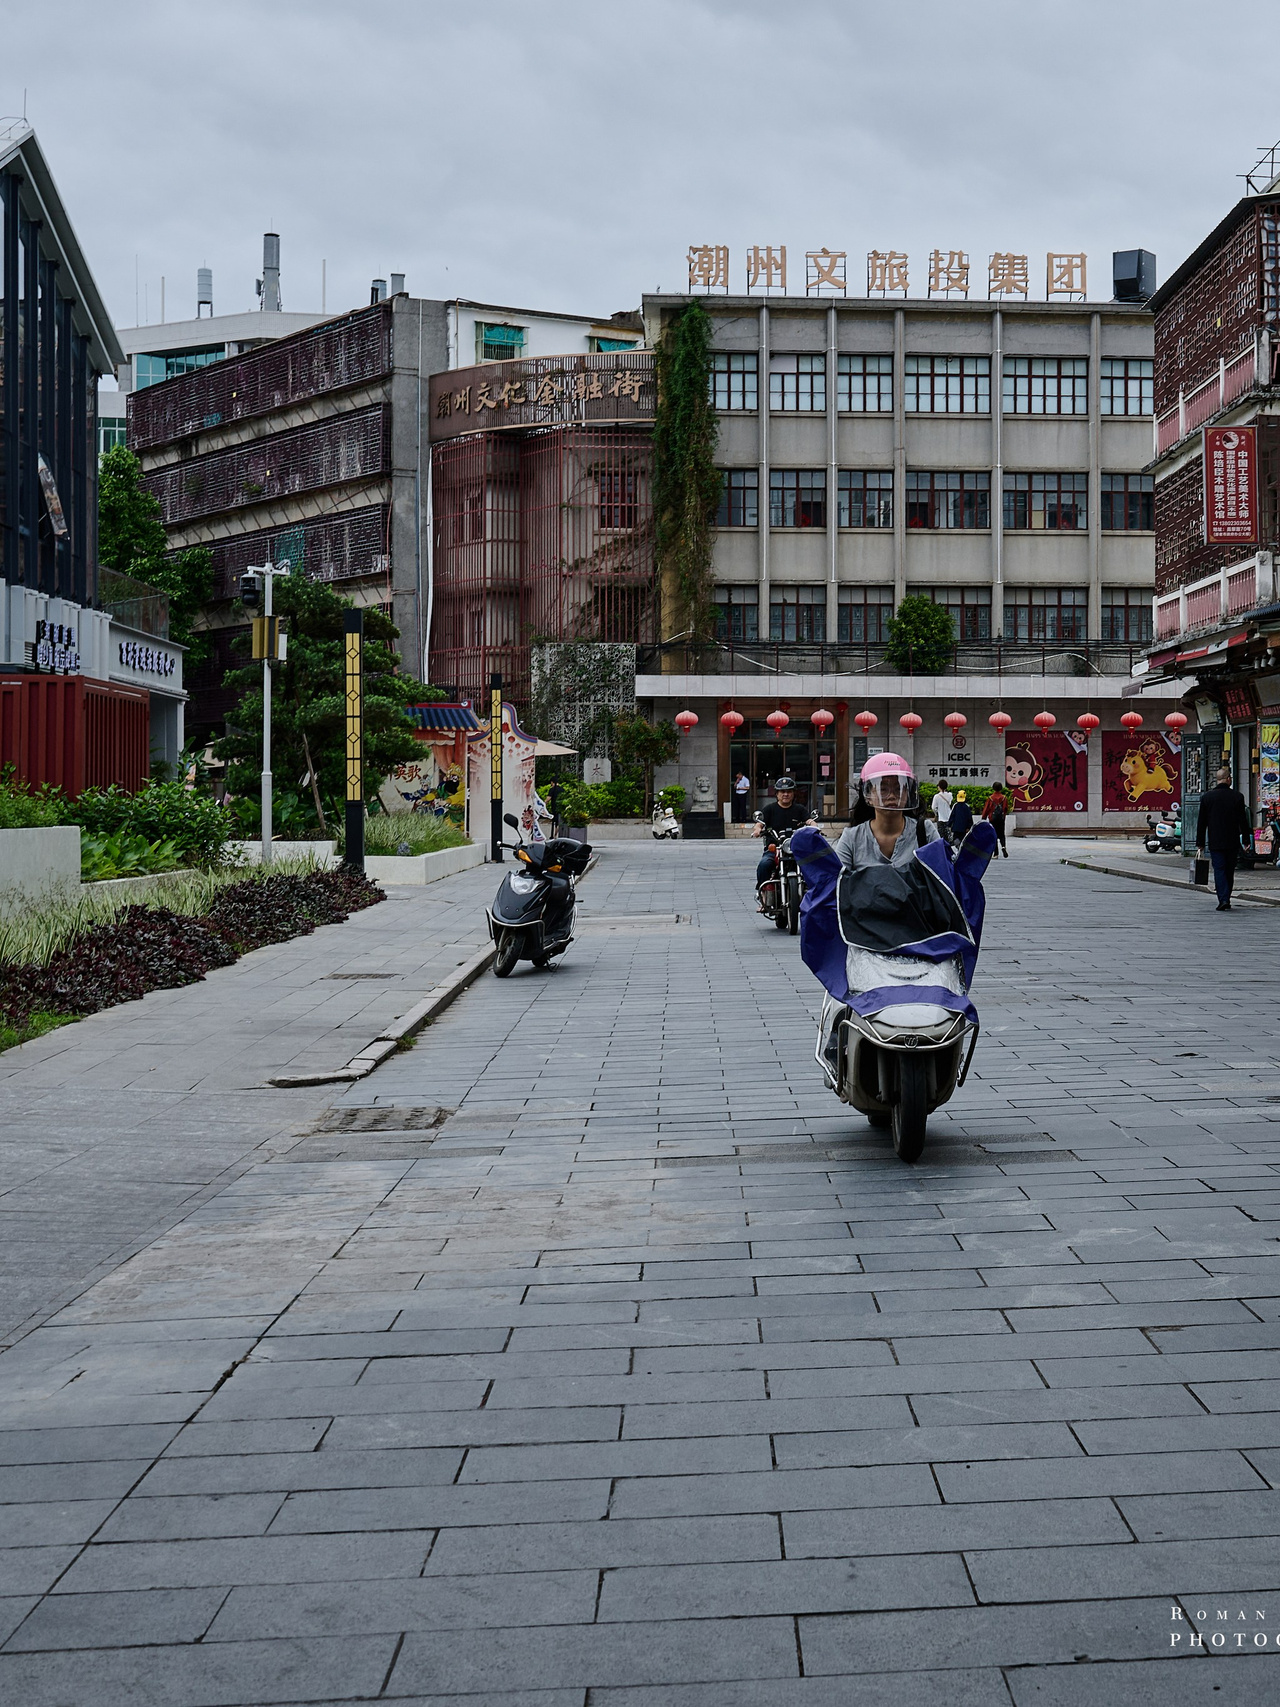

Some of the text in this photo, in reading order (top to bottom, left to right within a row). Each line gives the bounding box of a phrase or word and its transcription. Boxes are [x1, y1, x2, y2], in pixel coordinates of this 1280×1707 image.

[686, 244, 1088, 294] 潮州文旅投集团
[435, 371, 644, 419] 潮州文化金融街
[1237, 450, 1249, 519] 中国工艺美术大师
[929, 767, 989, 778] 中国工商银行
[948, 753, 971, 761] ICBC
[1042, 753, 1078, 791] 潮
